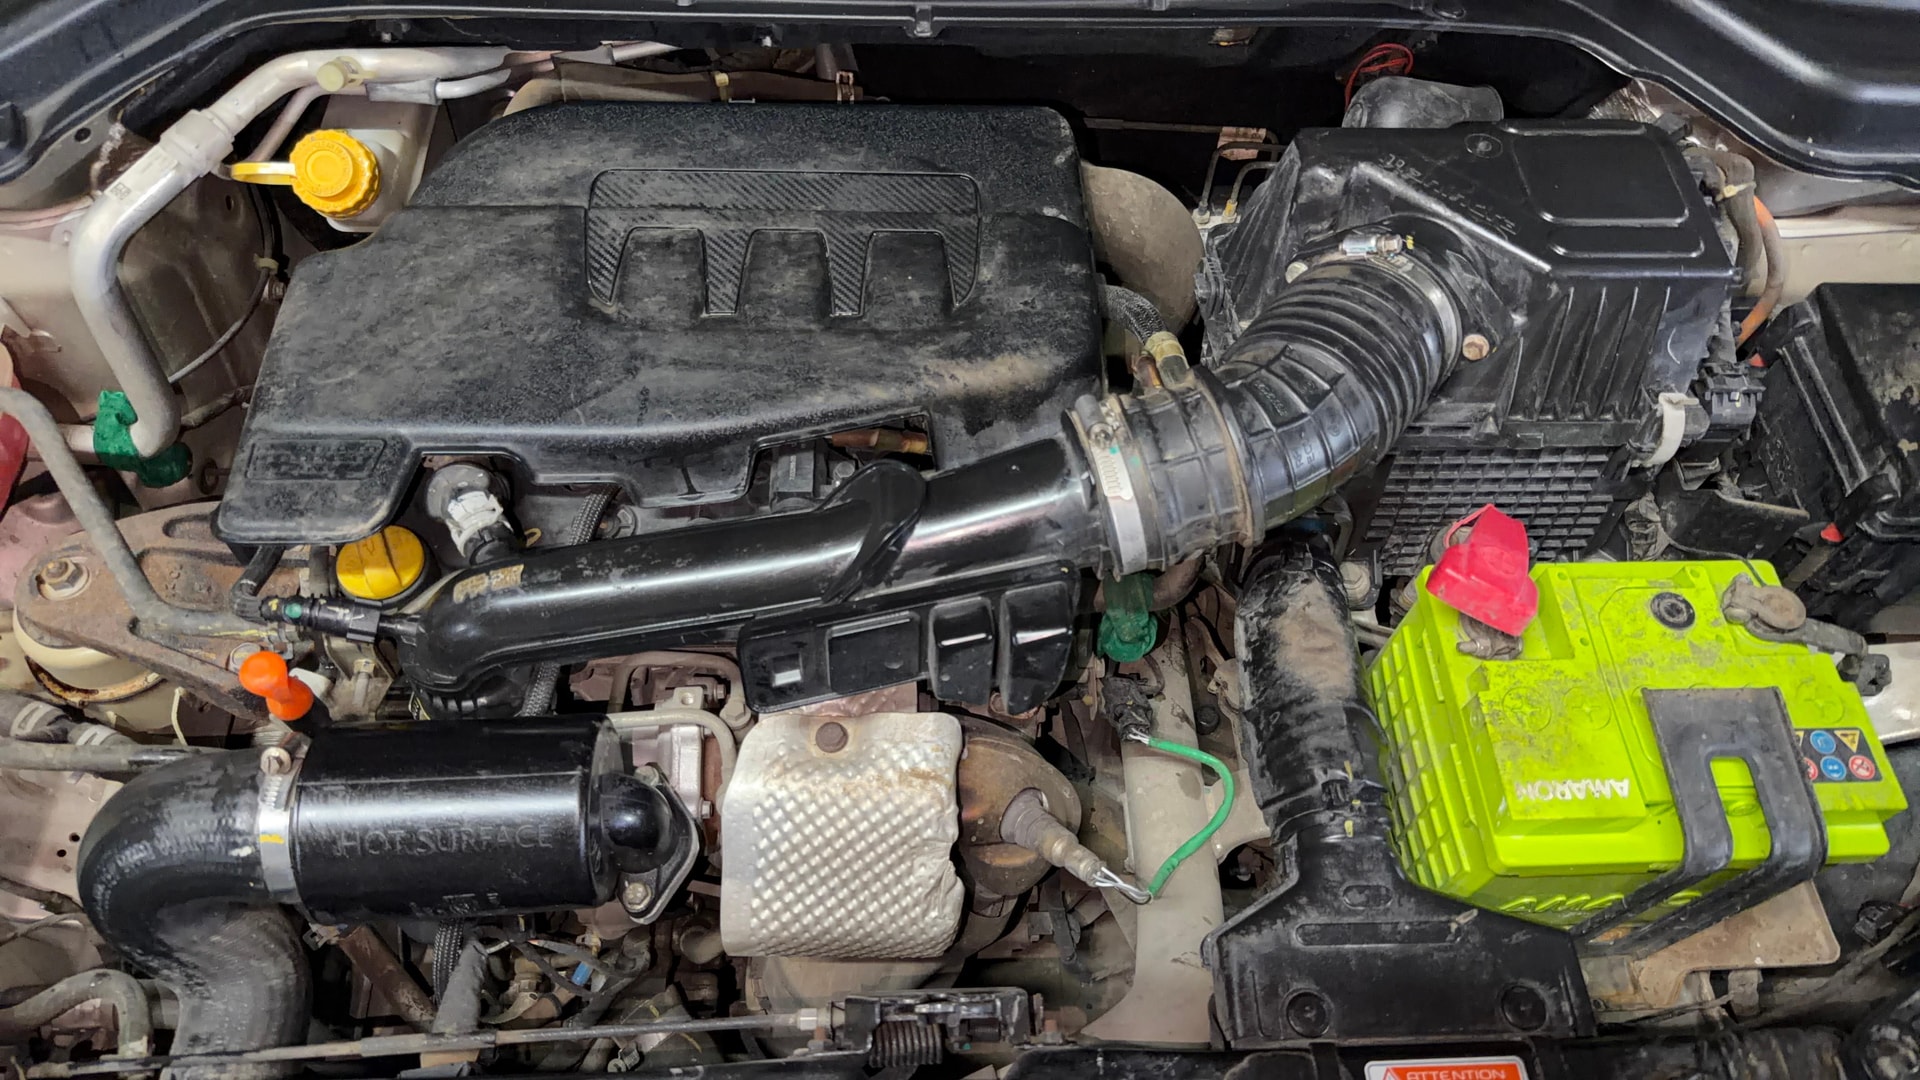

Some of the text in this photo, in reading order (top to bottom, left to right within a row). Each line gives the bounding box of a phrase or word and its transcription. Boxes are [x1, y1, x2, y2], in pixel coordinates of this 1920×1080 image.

[1515, 778, 1630, 801] AMARON
[340, 824, 553, 856] HOT SURFACE
[1406, 1069, 1506, 1080] ATTENTION
